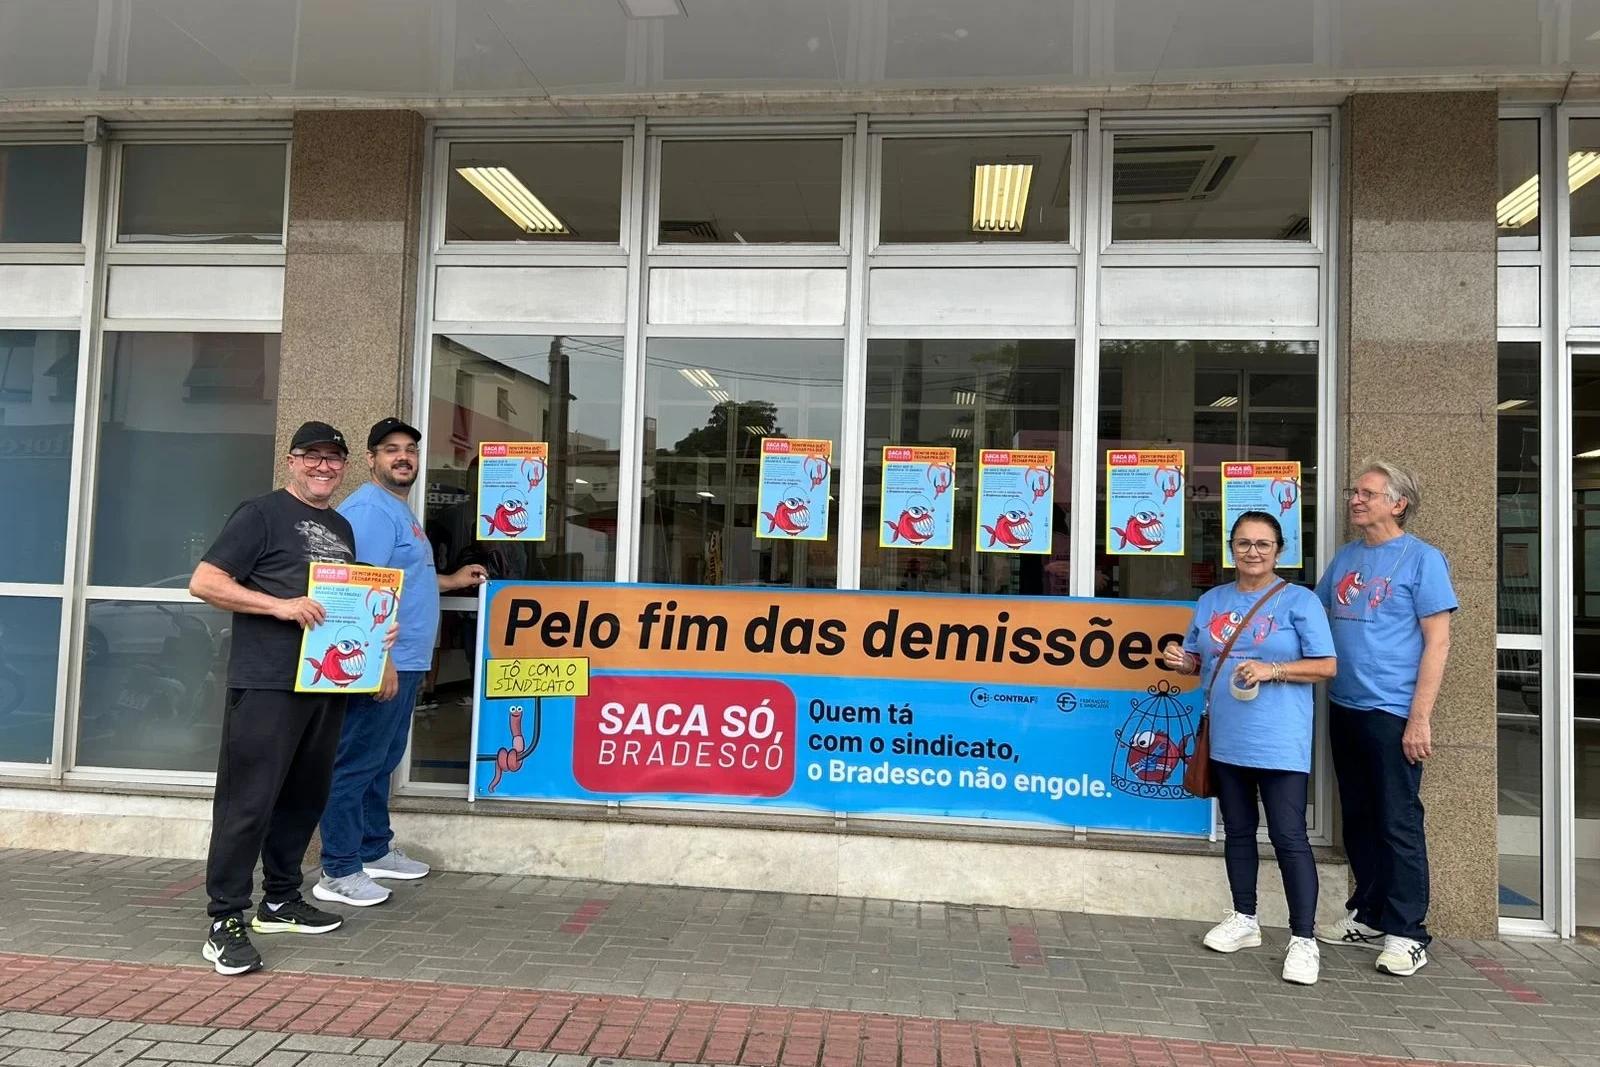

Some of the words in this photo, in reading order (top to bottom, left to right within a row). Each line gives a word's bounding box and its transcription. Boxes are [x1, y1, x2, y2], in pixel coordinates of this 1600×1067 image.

[504, 598, 621, 649] Pelo
[638, 600, 729, 651] fim
[744, 605, 847, 656] das
[494, 678, 575, 692] SINDICATO
[500, 660, 521, 680] TÔ
[527, 663, 560, 678] COM
[566, 663, 577, 676] O
[598, 702, 709, 737] SACA
[720, 699, 783, 744] SÓ,
[809, 698, 880, 724] Quem
[888, 703, 913, 725] tá
[598, 740, 783, 771] BRADESCO
[808, 733, 862, 753] com
[869, 736, 885, 753] o
[892, 732, 1020, 764] sindicato,
[807, 762, 823, 781] o
[829, 759, 952, 787] Bradesco
[959, 766, 1007, 790] não
[1013, 773, 1112, 800] engole.
